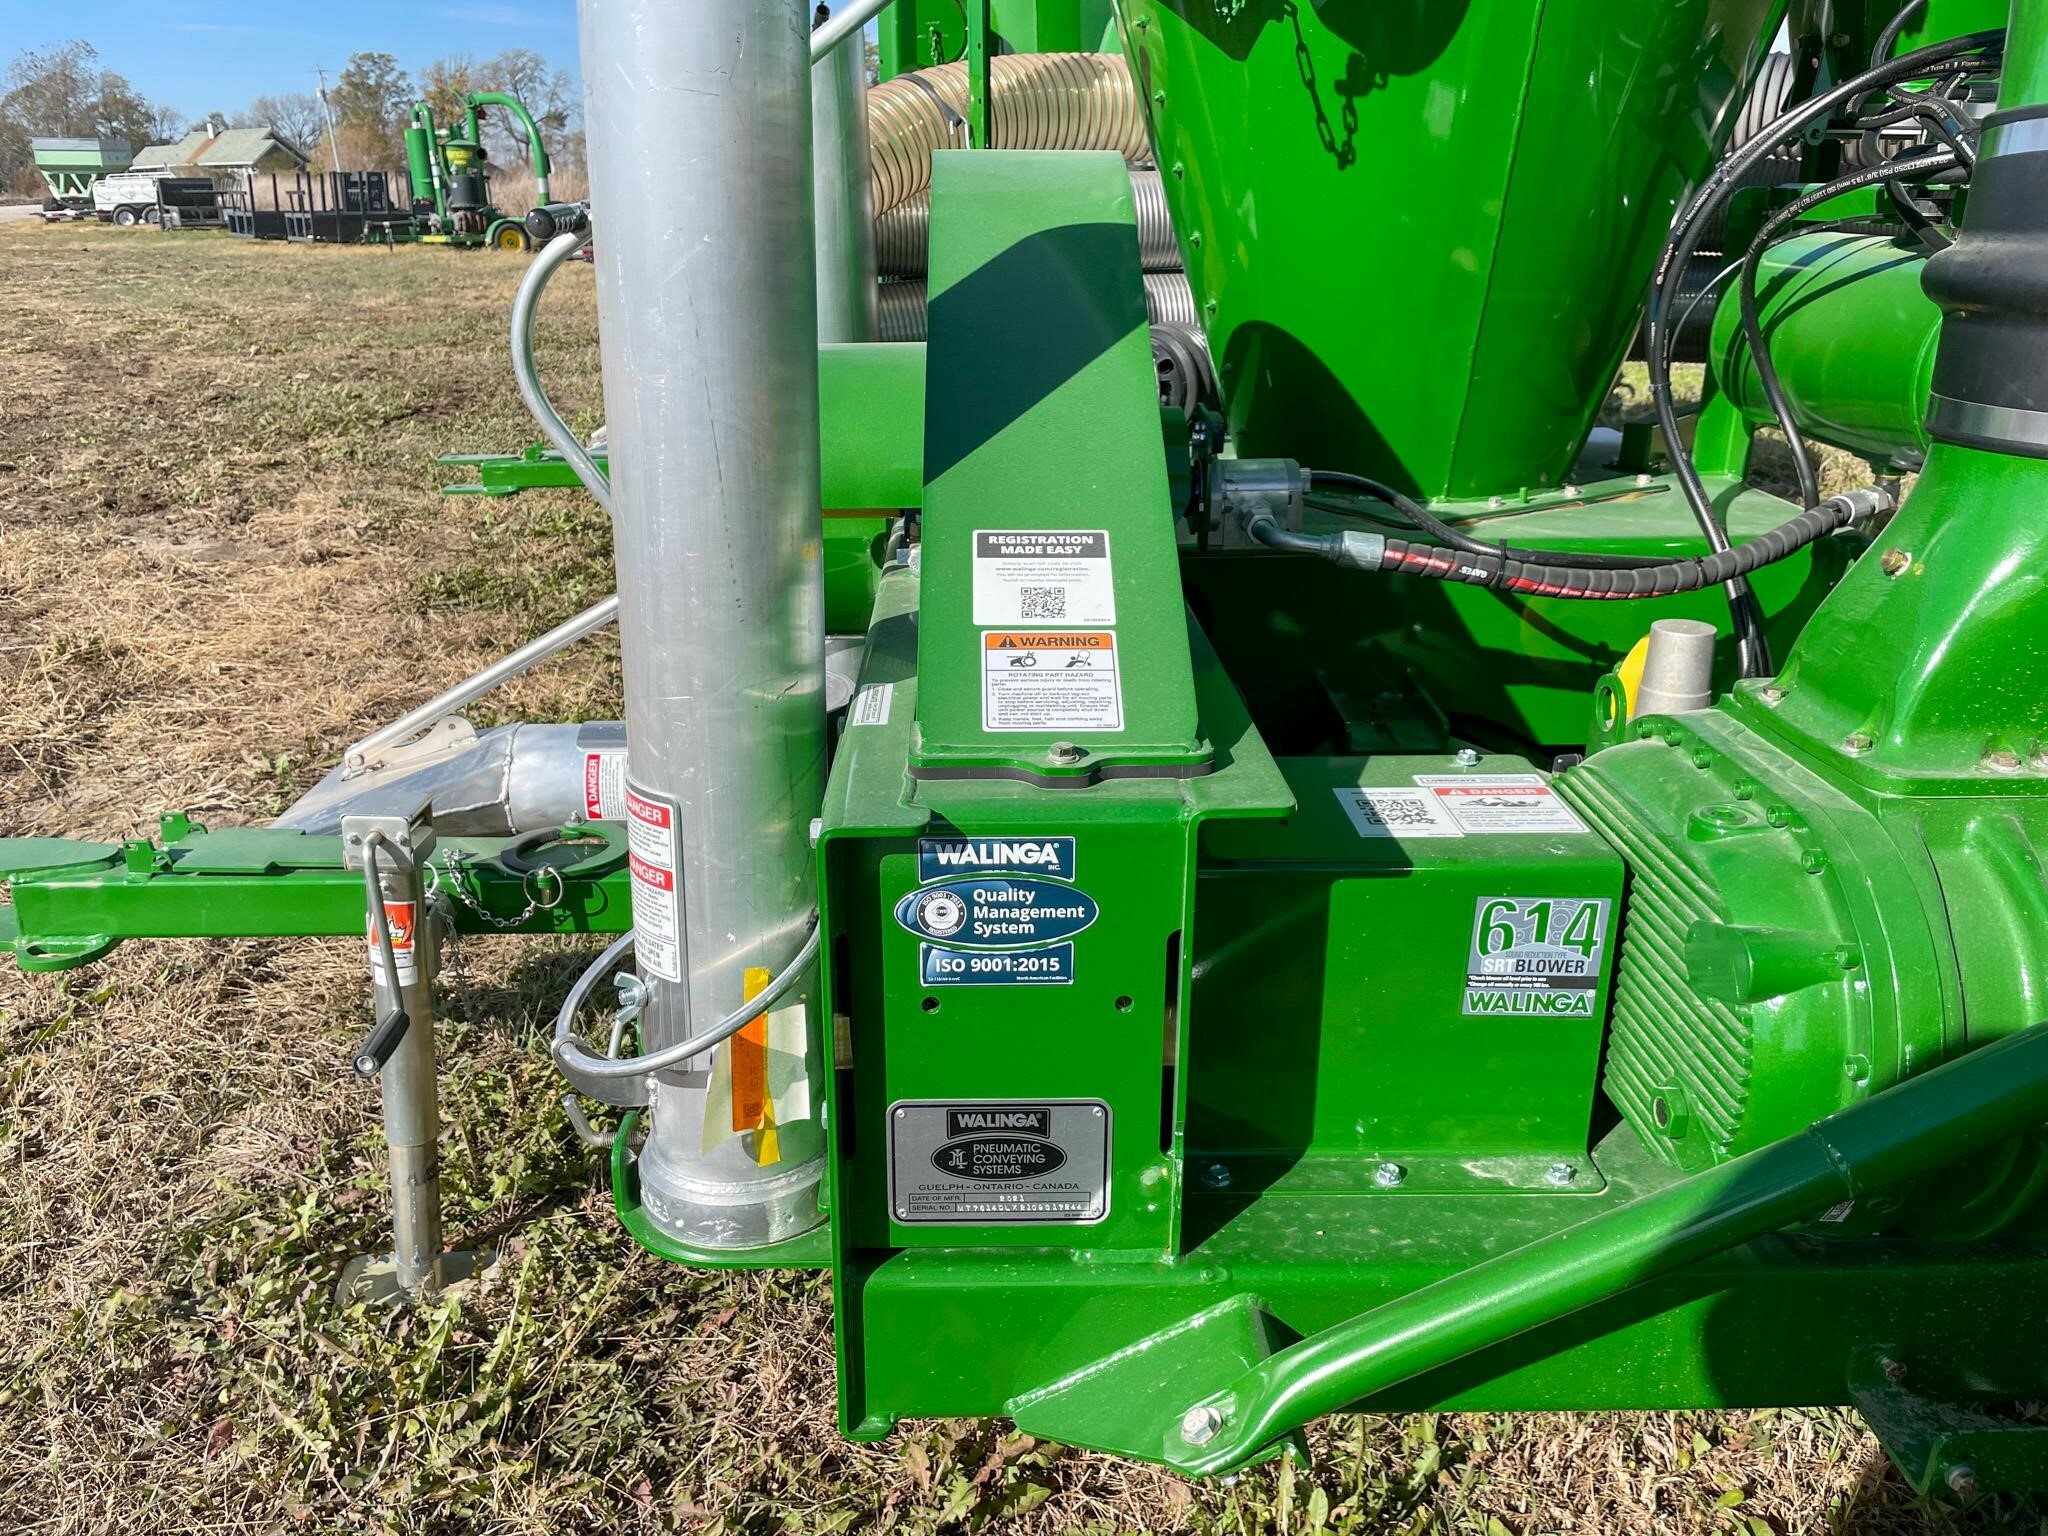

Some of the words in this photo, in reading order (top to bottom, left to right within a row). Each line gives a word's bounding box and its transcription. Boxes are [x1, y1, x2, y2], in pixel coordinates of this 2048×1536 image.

[988, 535, 1094, 544] REGISTRATION
[1000, 545, 1044, 554] MADE
[1046, 545, 1082, 554] EASY
[1460, 566, 1488, 578] GATES
[1020, 637, 1100, 647] WARNING
[588, 758, 599, 801] DANGER
[626, 792, 662, 824] ANGER
[936, 842, 1058, 866] WALINGA
[922, 897, 932, 906] ISO
[973, 889, 1035, 905] Quality
[974, 906, 1085, 922] Management
[974, 921, 1034, 938] System
[1476, 898, 1602, 962] 614
[936, 958, 965, 972] ISO
[971, 957, 1060, 972] 9001:2015
[1466, 991, 1590, 1014] WALINGA
[958, 1113, 1039, 1128] WALINGA
[973, 1144, 1041, 1153] PNEUMATIC
[973, 1154, 1046, 1164] CONVEYING
[973, 1165, 1022, 1174] SYSTEMS
